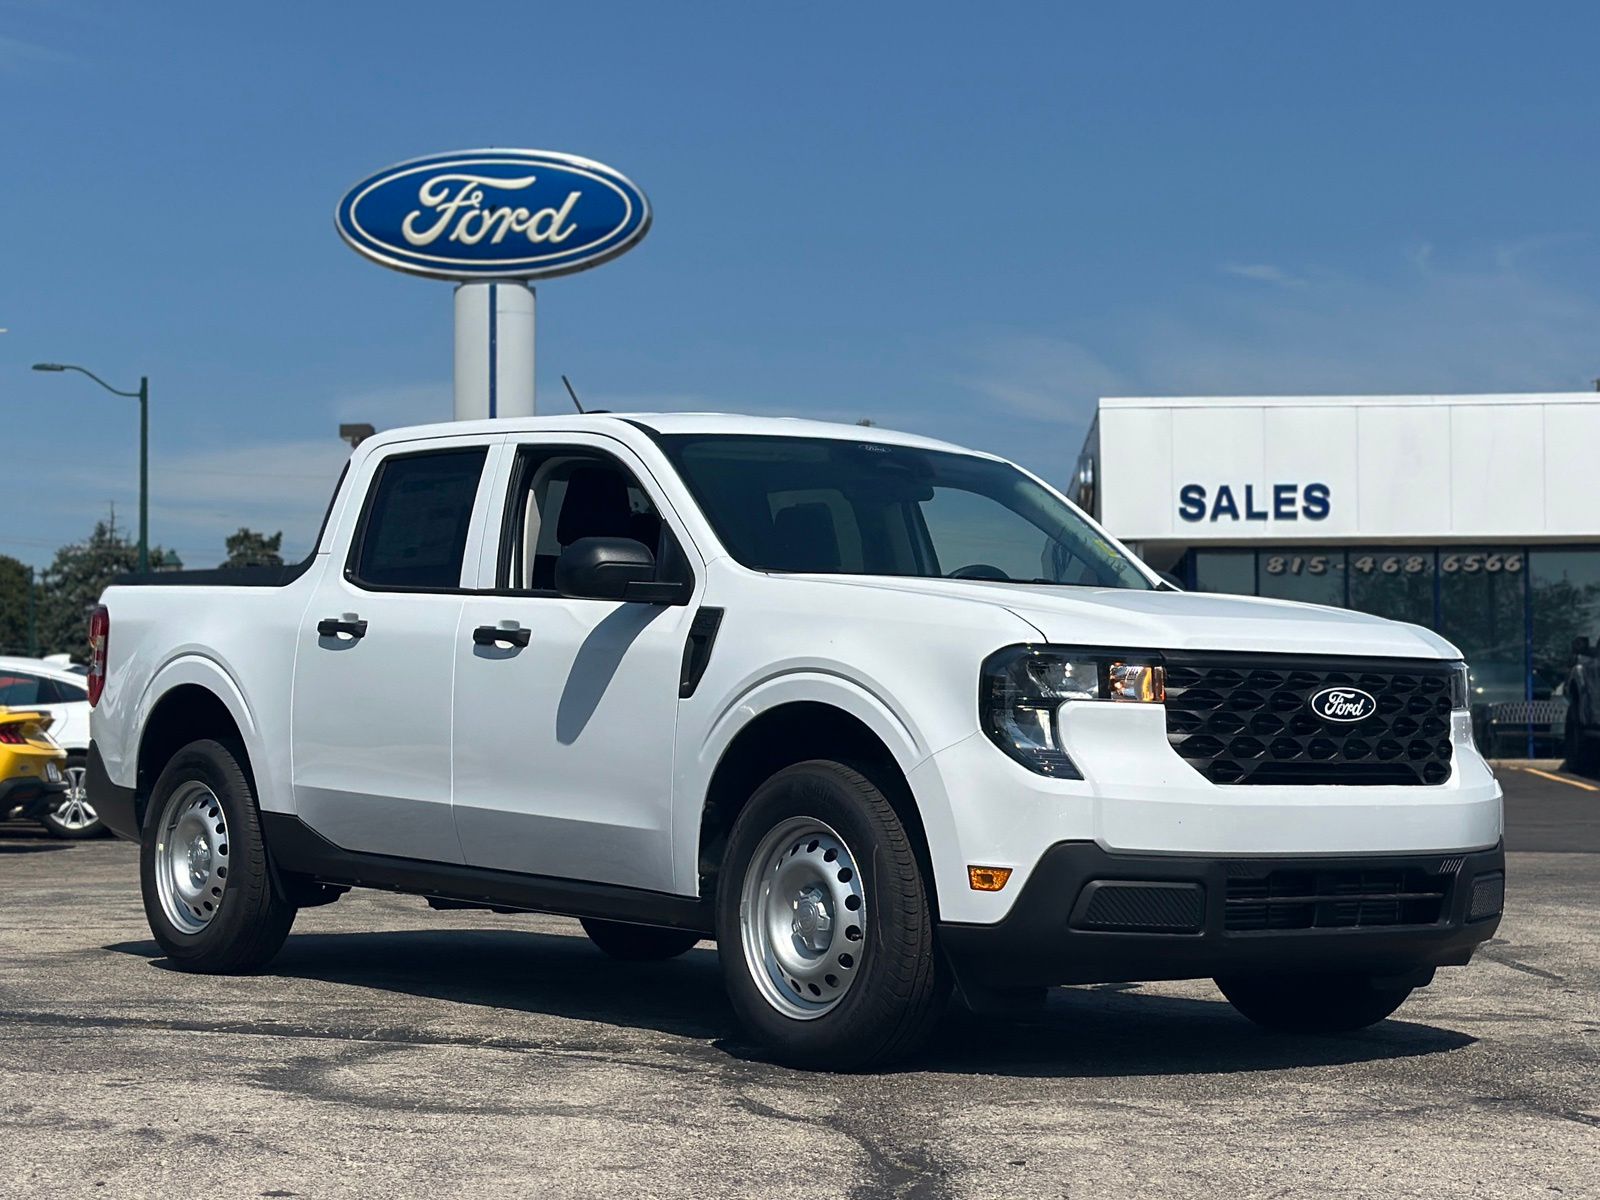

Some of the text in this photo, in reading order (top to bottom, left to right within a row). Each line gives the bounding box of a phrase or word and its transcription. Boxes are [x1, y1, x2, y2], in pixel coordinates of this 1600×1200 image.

[402, 174, 582, 245] Ford
[1178, 483, 1331, 522] SALES
[1324, 691, 1365, 716] Ford
